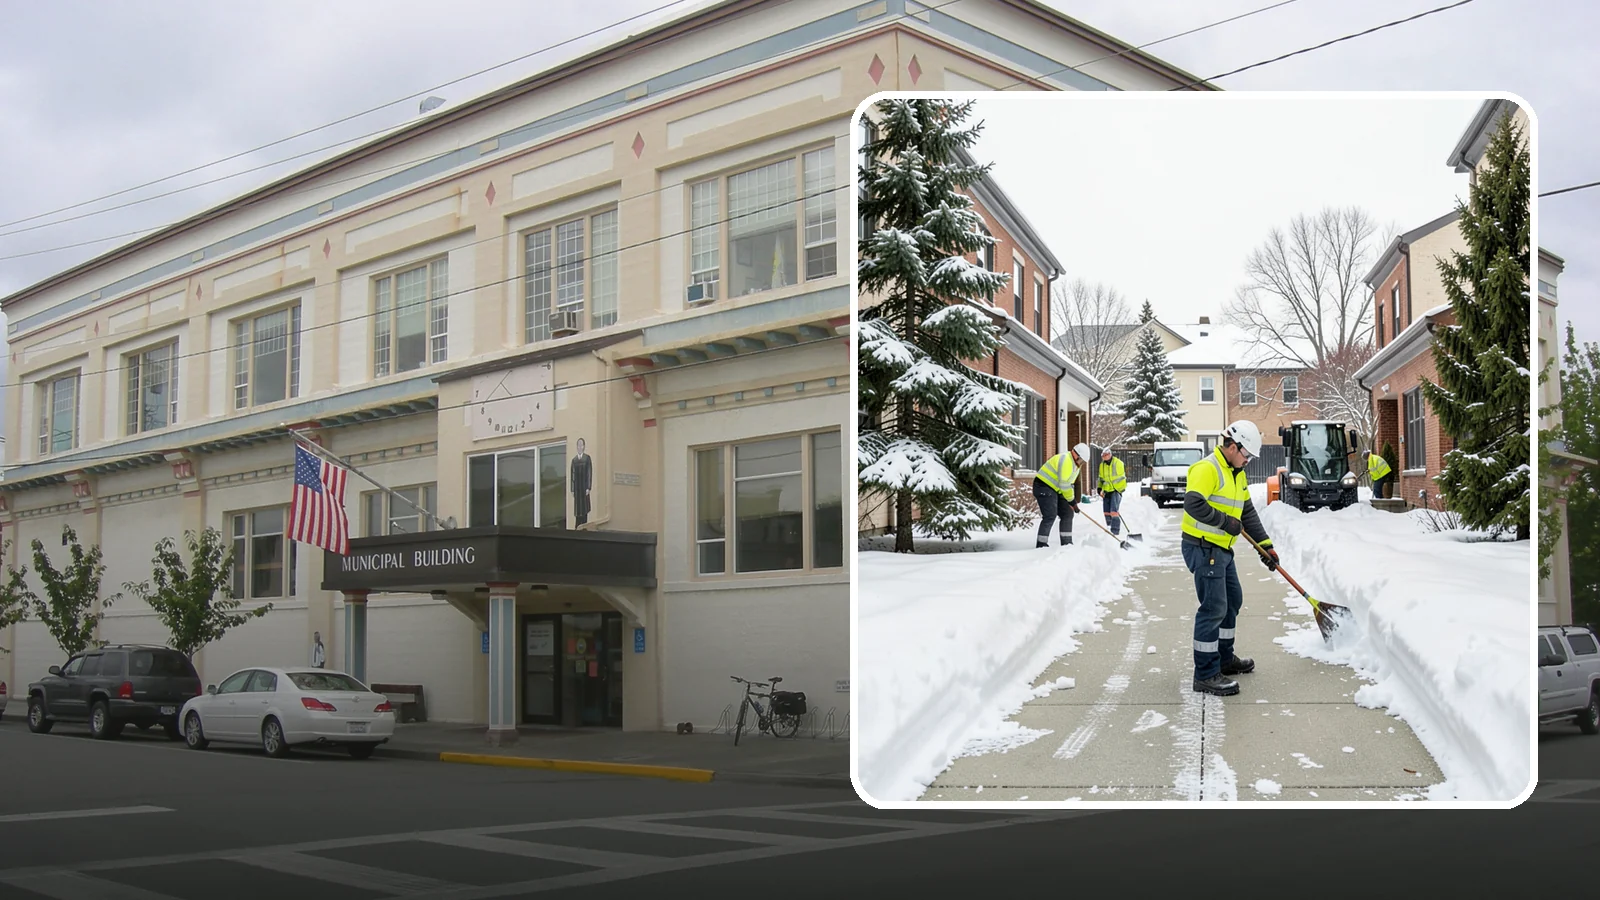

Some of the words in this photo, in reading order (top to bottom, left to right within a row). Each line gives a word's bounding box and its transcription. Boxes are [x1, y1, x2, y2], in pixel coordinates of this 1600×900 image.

[488, 418, 492, 426] 9
[495, 424, 500, 432] 10
[342, 552, 405, 572] MUNICIPAL
[414, 546, 475, 567] BUILDING
